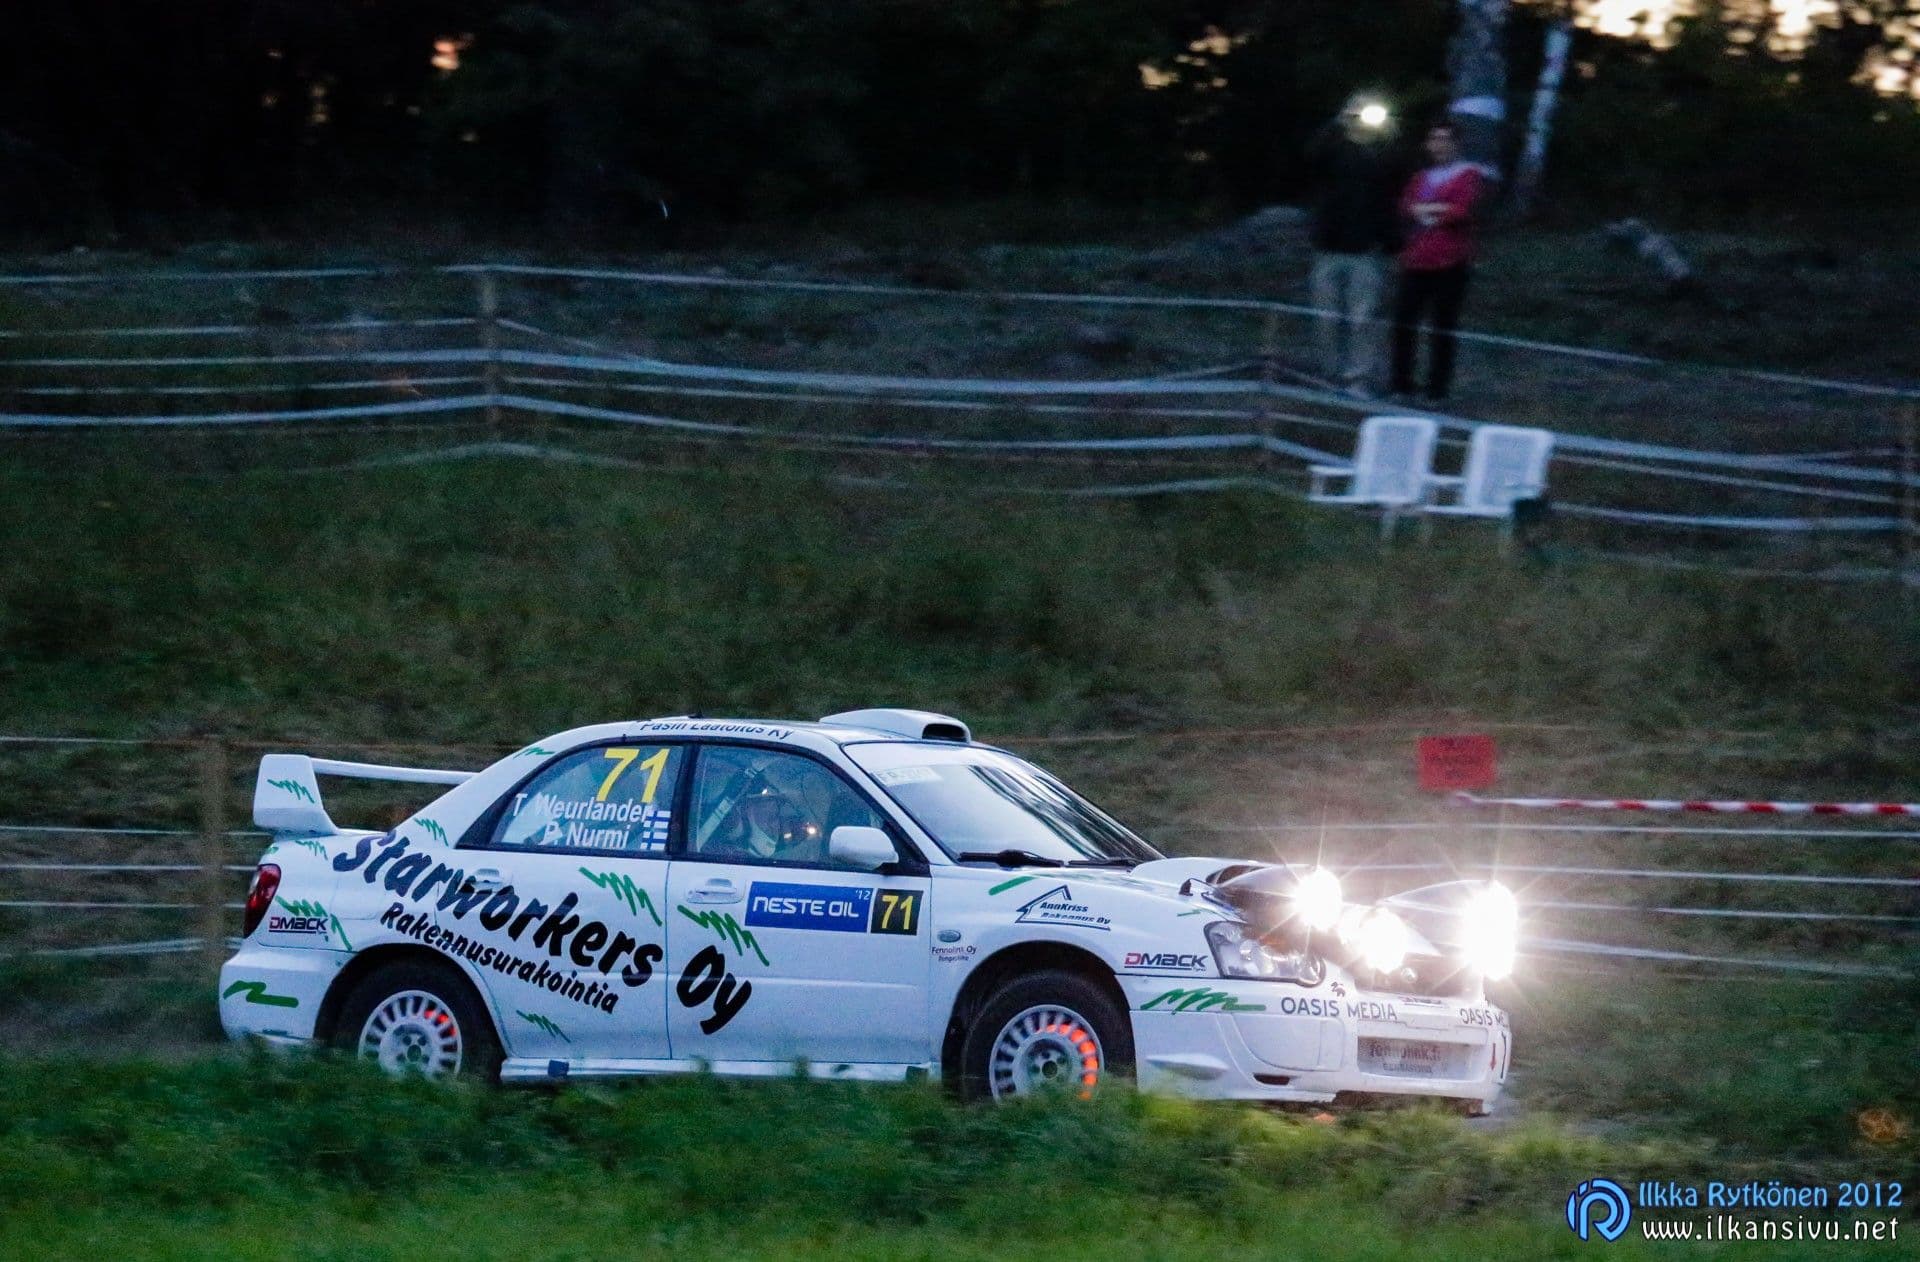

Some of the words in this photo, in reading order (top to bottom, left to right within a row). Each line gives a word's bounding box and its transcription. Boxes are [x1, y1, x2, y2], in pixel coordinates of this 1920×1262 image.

[596, 747, 671, 803] 71
[566, 822, 631, 850] Nurmi
[828, 900, 860, 918] OIL
[881, 894, 914, 931] 71
[333, 829, 664, 988] Starworkers
[676, 944, 753, 1035] Oy
[380, 901, 619, 1015] Rakennusurakointia
[1281, 996, 1340, 1017] OASIS
[1347, 1001, 1398, 1020] MEDIA
